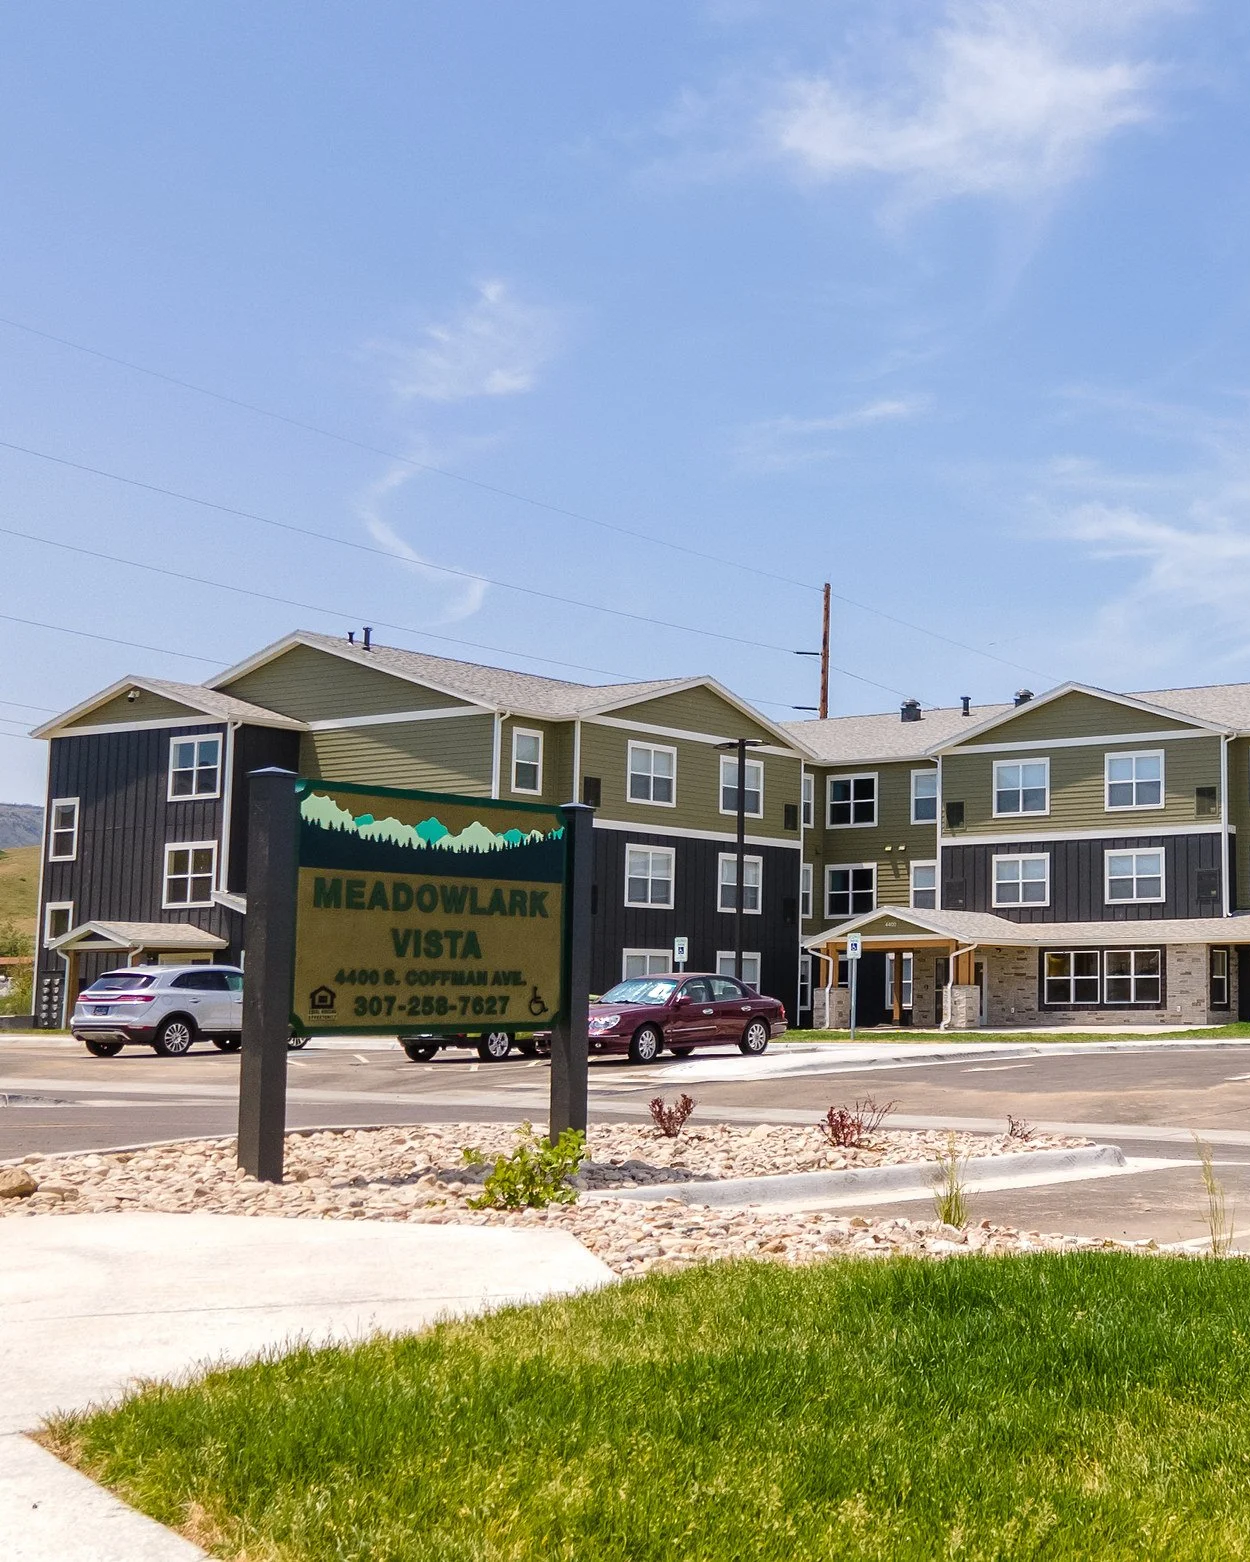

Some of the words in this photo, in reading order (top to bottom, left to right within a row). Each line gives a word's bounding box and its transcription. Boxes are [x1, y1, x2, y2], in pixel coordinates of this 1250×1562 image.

[313, 876, 550, 918] MEADOWLARK
[390, 928, 483, 960] VISTA
[334, 969, 380, 986] 4400
[384, 969, 401, 986] S.
[405, 970, 488, 987] COFFMAN
[491, 970, 527, 987] AVE.
[353, 995, 511, 1017] 307-258-7627
